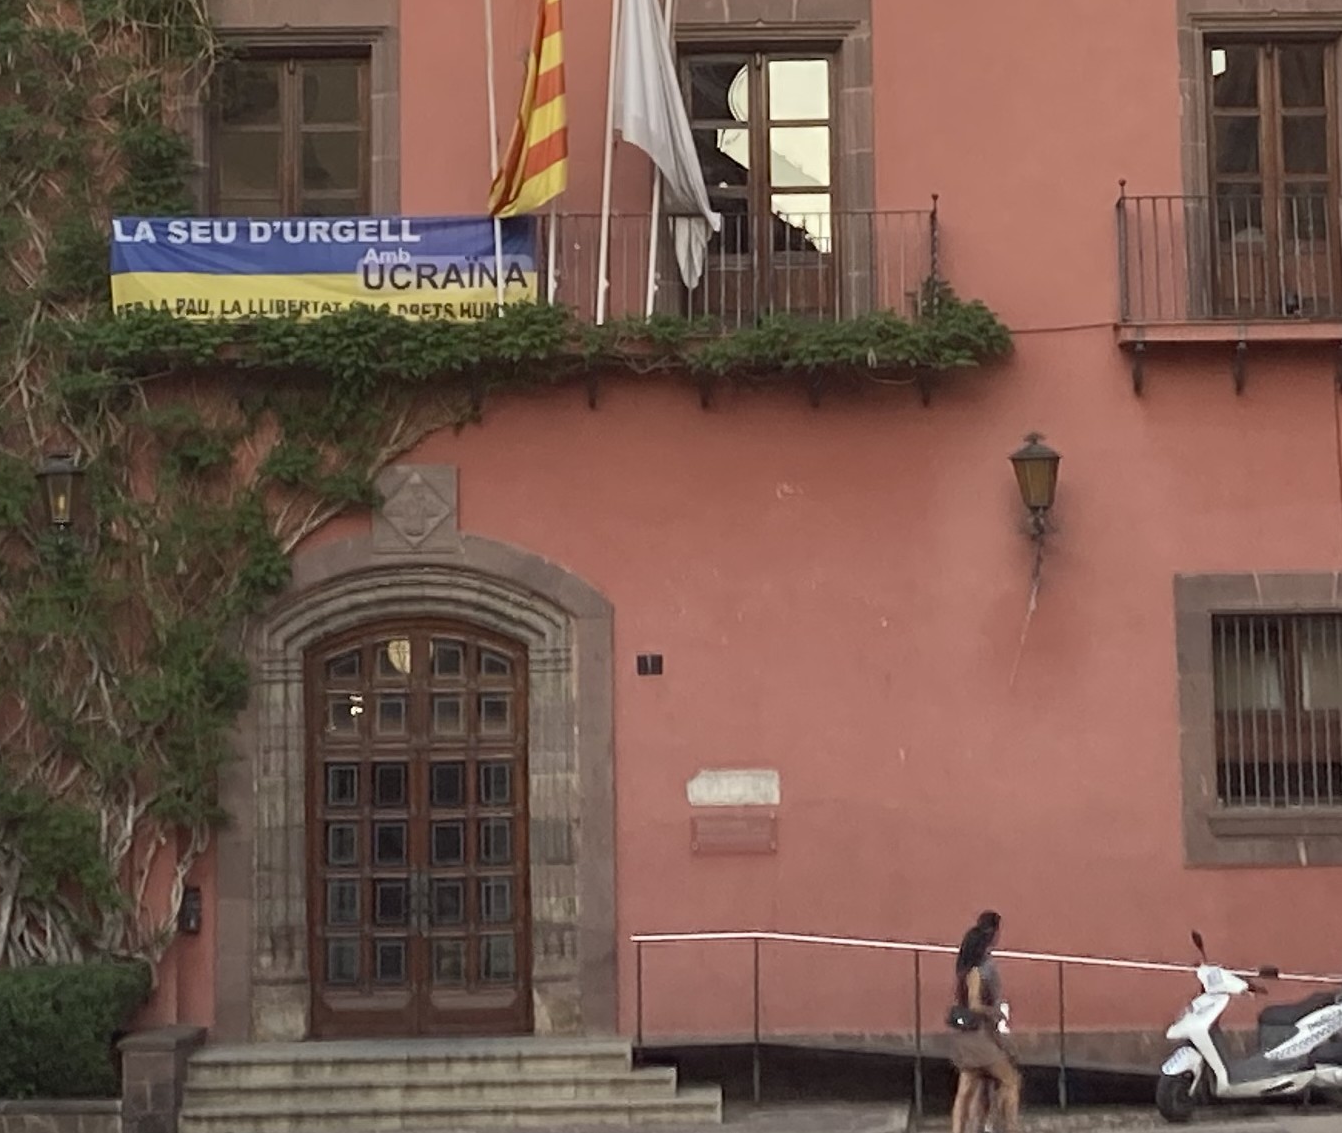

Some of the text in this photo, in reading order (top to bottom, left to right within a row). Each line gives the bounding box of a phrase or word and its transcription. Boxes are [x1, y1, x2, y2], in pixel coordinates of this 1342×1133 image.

[113, 219, 421, 244] LA SEU D'URGELL
[363, 247, 411, 264] Amb
[363, 256, 528, 290] UCRAÏNA
[221, 299, 243, 315] LA
[248, 299, 342, 317] LLIBERTAT
